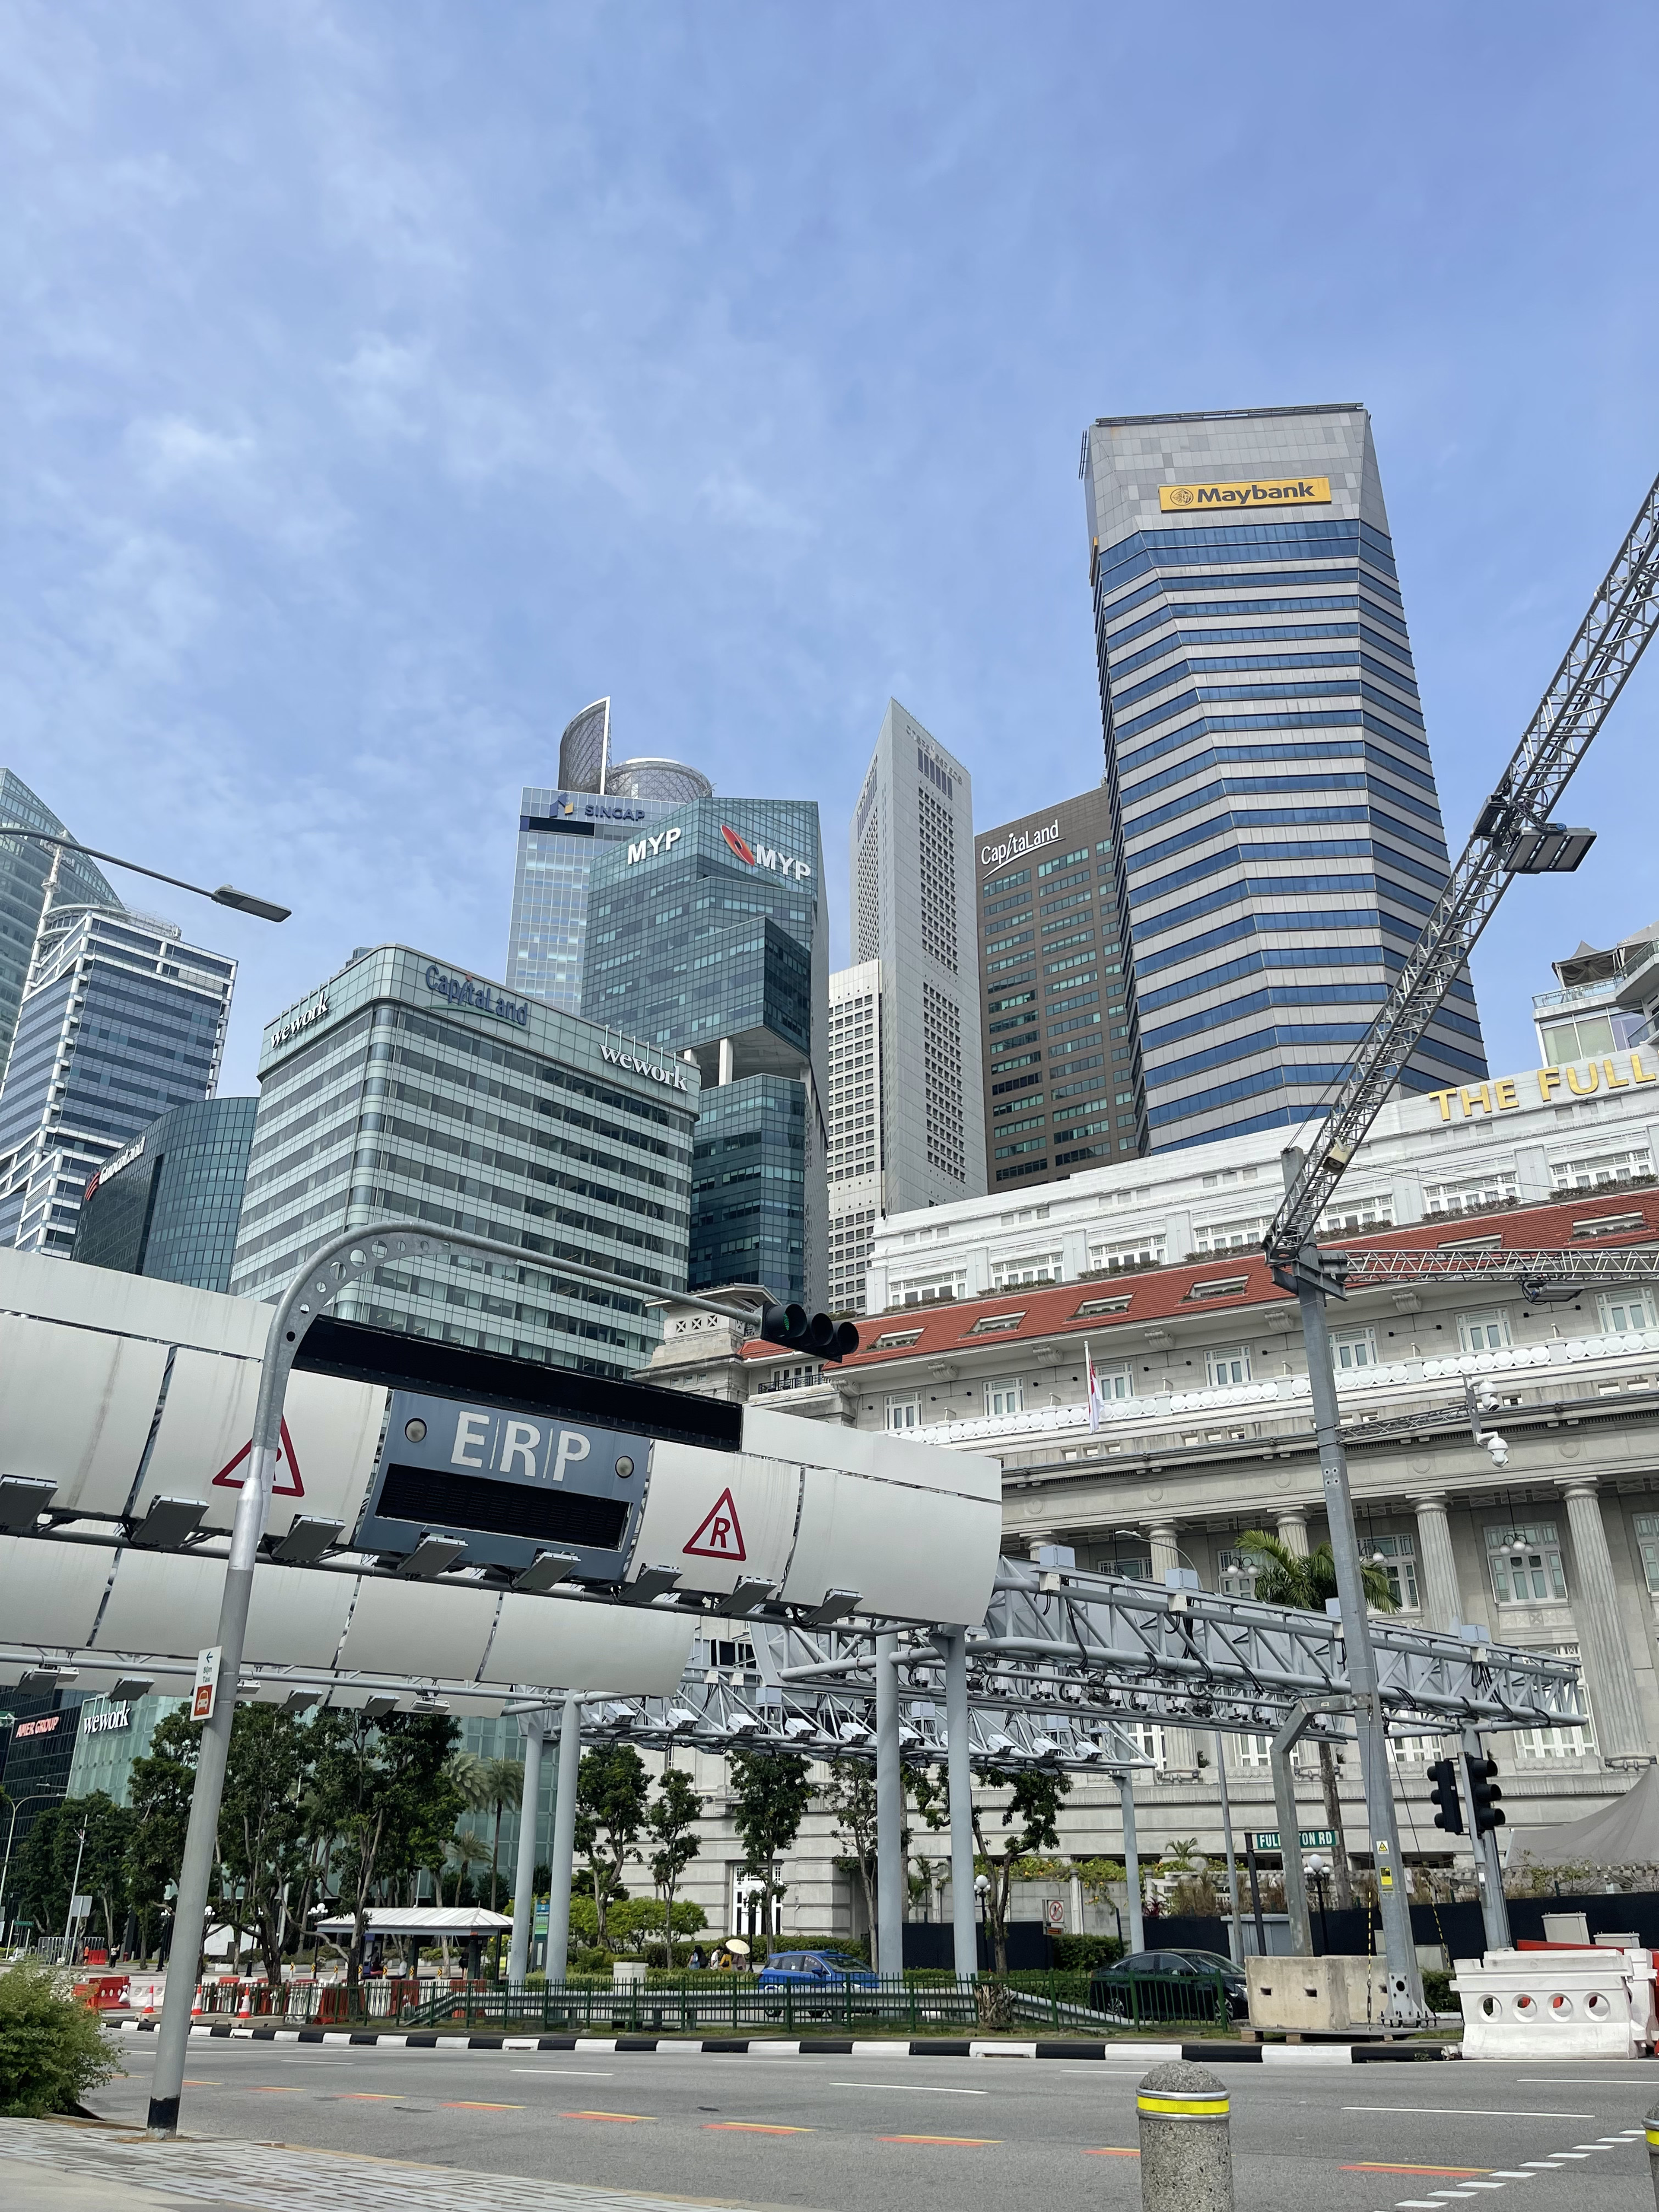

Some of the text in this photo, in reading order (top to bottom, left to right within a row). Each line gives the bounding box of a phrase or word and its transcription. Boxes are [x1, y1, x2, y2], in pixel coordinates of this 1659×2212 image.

[1197, 482, 1315, 505] Maybank
[628, 827, 681, 865] MYP
[981, 819, 1059, 864] CapitaLand
[756, 844, 810, 880] MYP
[426, 965, 528, 1026] CapitaLand
[271, 991, 330, 1048] wework
[598, 1043, 689, 1092] wework
[1428, 1050, 1659, 1121] THE FULL
[709, 1516, 731, 1548] R
[203, 1675, 211, 1683] Taxi
[35, 1716, 60, 1734] GROUP
[83, 1700, 130, 1734] wework
[1319, 1831, 1333, 1845] RD
